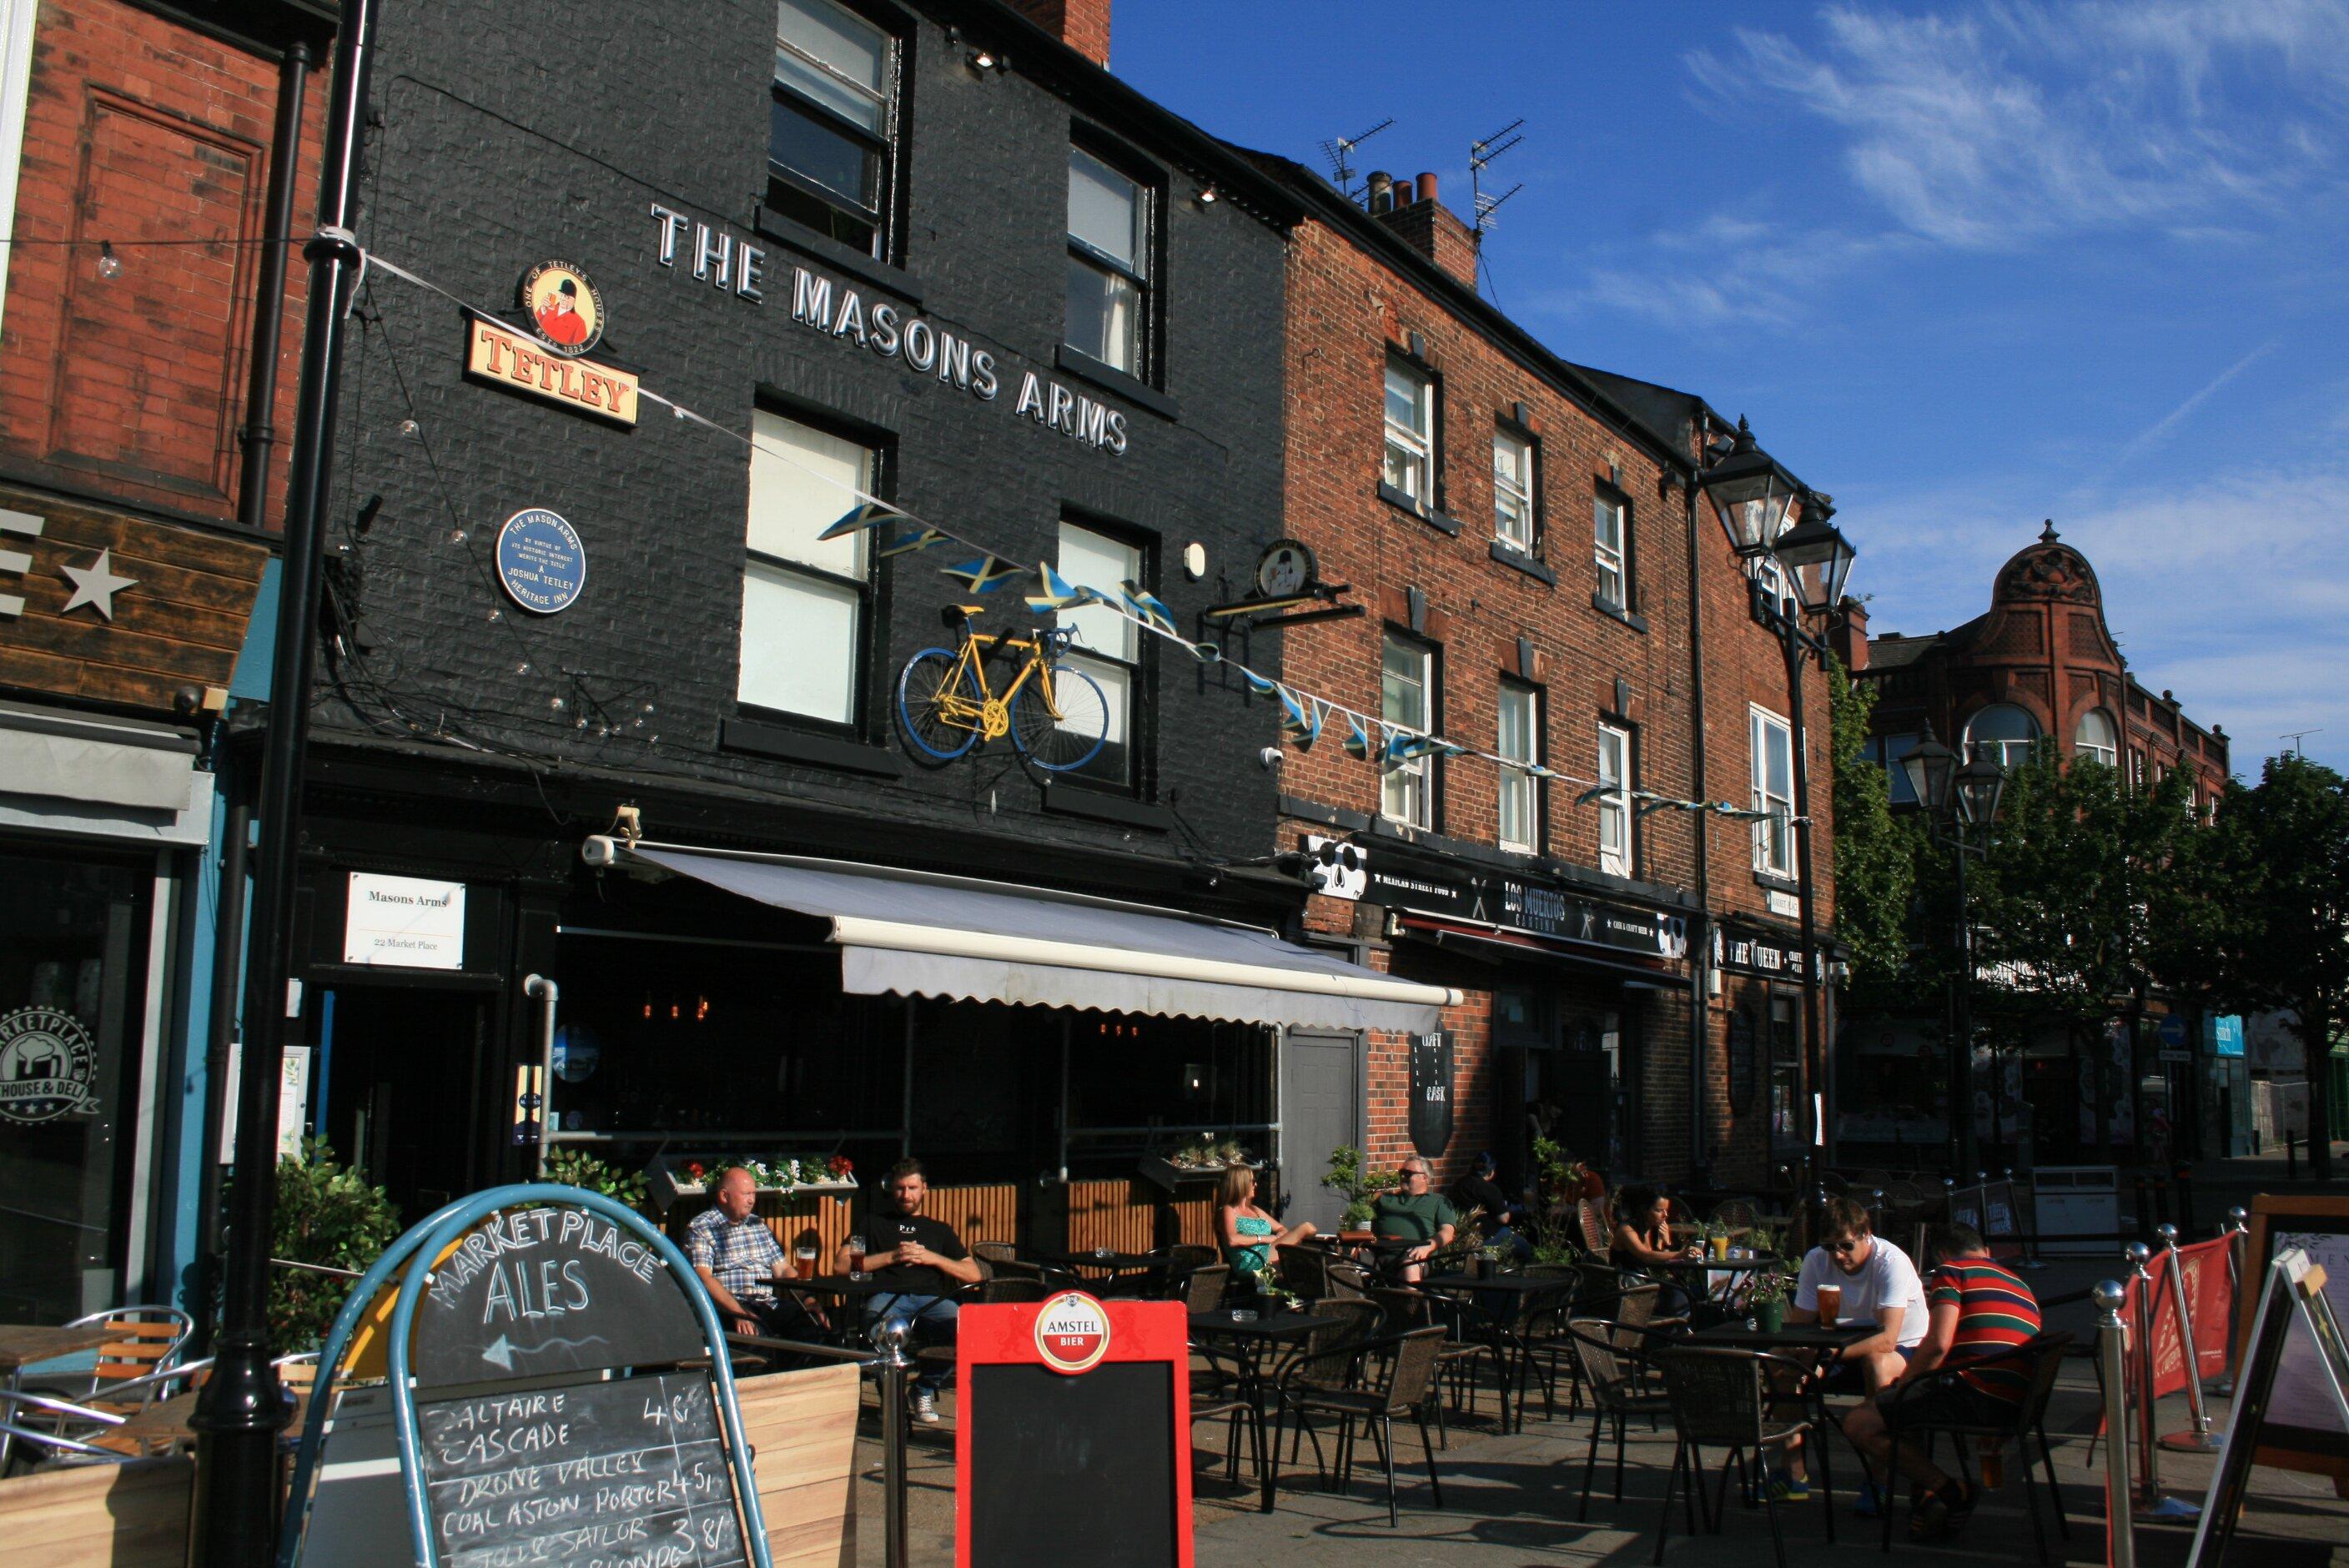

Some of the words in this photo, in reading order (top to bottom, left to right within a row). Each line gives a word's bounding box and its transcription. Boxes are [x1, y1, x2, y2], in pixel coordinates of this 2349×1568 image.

[531, 268, 541, 279] OF
[547, 260, 588, 282] TETLEY'S
[591, 289, 603, 332] HOUSES
[650, 202, 766, 304] THE
[790, 266, 998, 401] MASONS
[1014, 370, 1128, 456] ARMS
[563, 344, 584, 354] 1822
[481, 329, 629, 413] TETLEY
[509, 519, 526, 535] THE
[526, 514, 558, 528] MASON
[557, 525, 578, 550] ARMS
[507, 567, 539, 582] JOSHUA
[543, 575, 574, 591] TETLEY
[538, 565, 545, 574] A
[511, 579, 550, 606] HERITAGE
[553, 591, 569, 604] INN
[368, 890, 414, 905] Masons
[416, 894, 448, 908] Arms
[1505, 881, 1522, 912] LOS
[1524, 887, 1565, 922] MUERTOS
[1516, 913, 1556, 932] CANTINA
[374, 938, 385, 947] 22
[387, 938, 416, 950] Market
[417, 940, 438, 951] Place
[1728, 940, 1748, 965] THE
[1750, 942, 1780, 970] QUEEN
[0, 1014, 88, 1065] RKETPLACE
[1426, 1086, 1446, 1102] CASK
[427, 1208, 557, 1309] MARKET
[558, 1210, 664, 1284] PLACE
[483, 1259, 589, 1324] ALES
[1048, 1320, 1097, 1333] AMSTEL
[1060, 1336, 1084, 1346] BIER
[439, 1423, 570, 1465] CASCADE
[460, 1465, 541, 1508] DRONE
[557, 1448, 646, 1485] VALLEY
[443, 1511, 500, 1537] COAL
[507, 1494, 580, 1526] ASTON
[596, 1479, 676, 1514] PORTER
[561, 1517, 648, 1558] SAILOR
